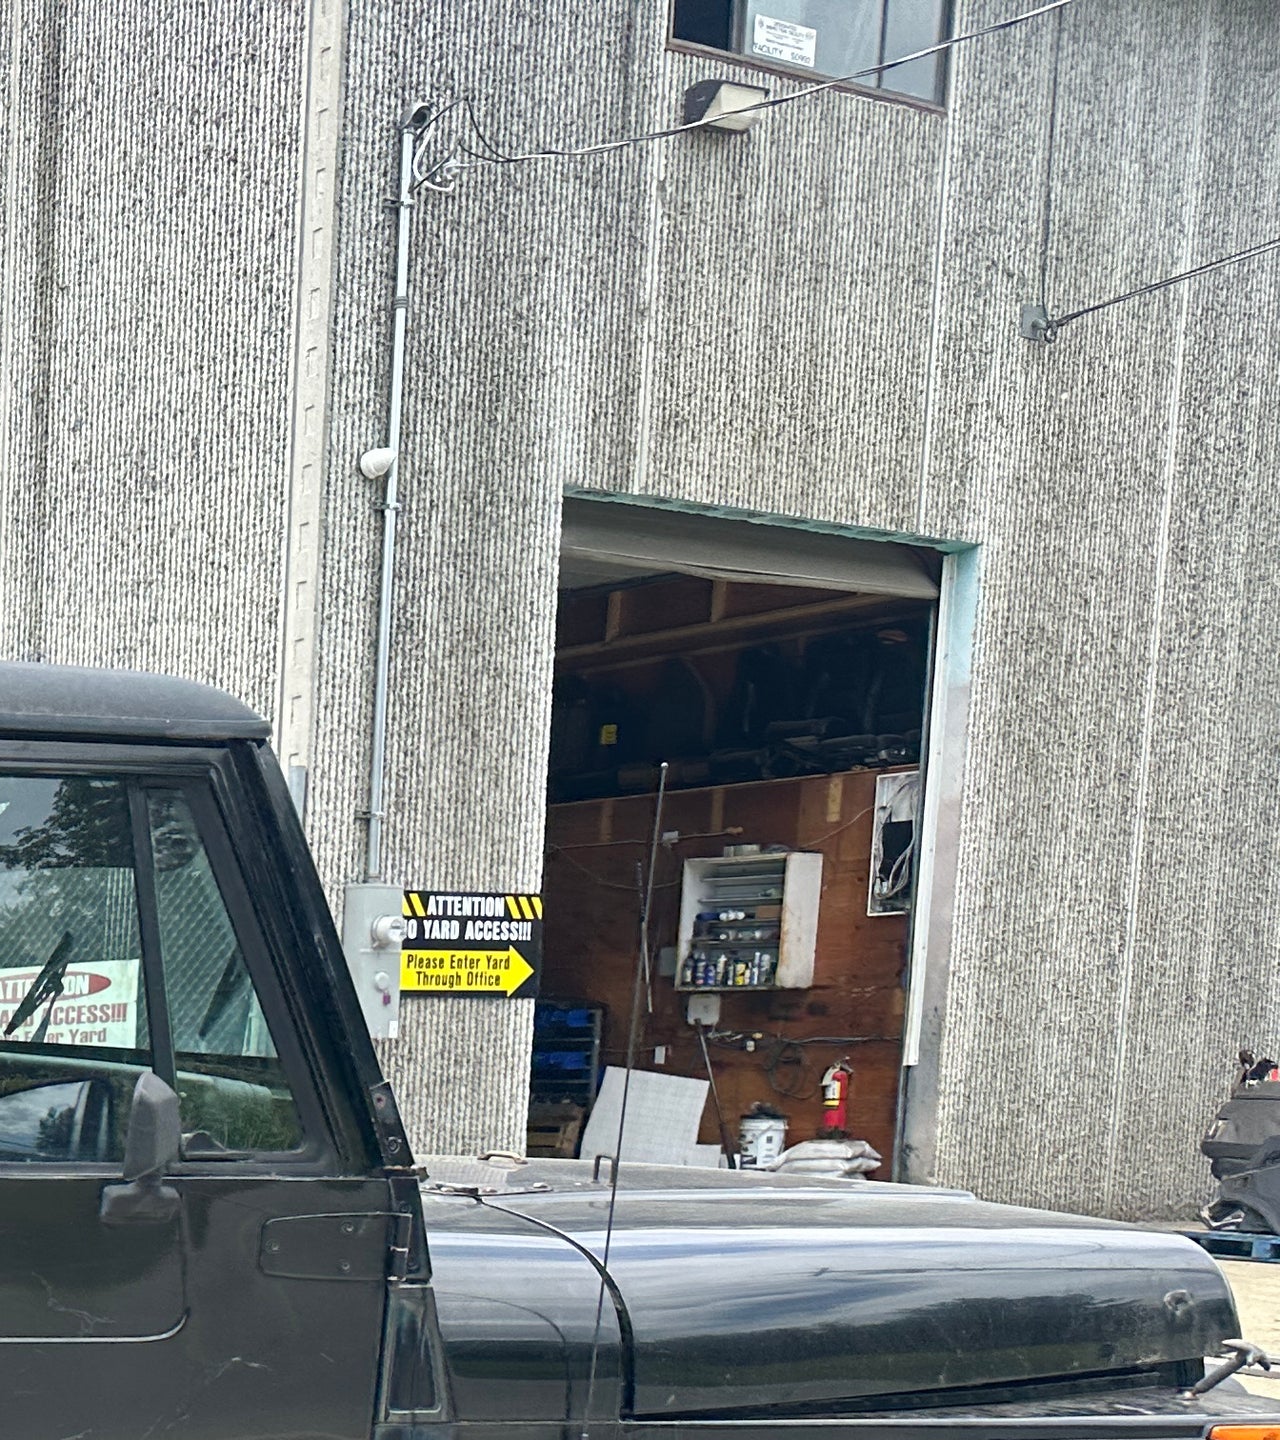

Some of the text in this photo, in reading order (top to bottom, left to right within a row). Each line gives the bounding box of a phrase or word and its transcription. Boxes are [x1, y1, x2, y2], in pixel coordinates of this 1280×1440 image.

[427, 895, 505, 917] ATTENTION
[423, 919, 460, 940] YARD
[464, 920, 532, 941] ACCESS!!!
[407, 954, 511, 970] Please Enter Yard
[416, 971, 501, 988] Through Office
[69, 1027, 107, 1044] Yard
